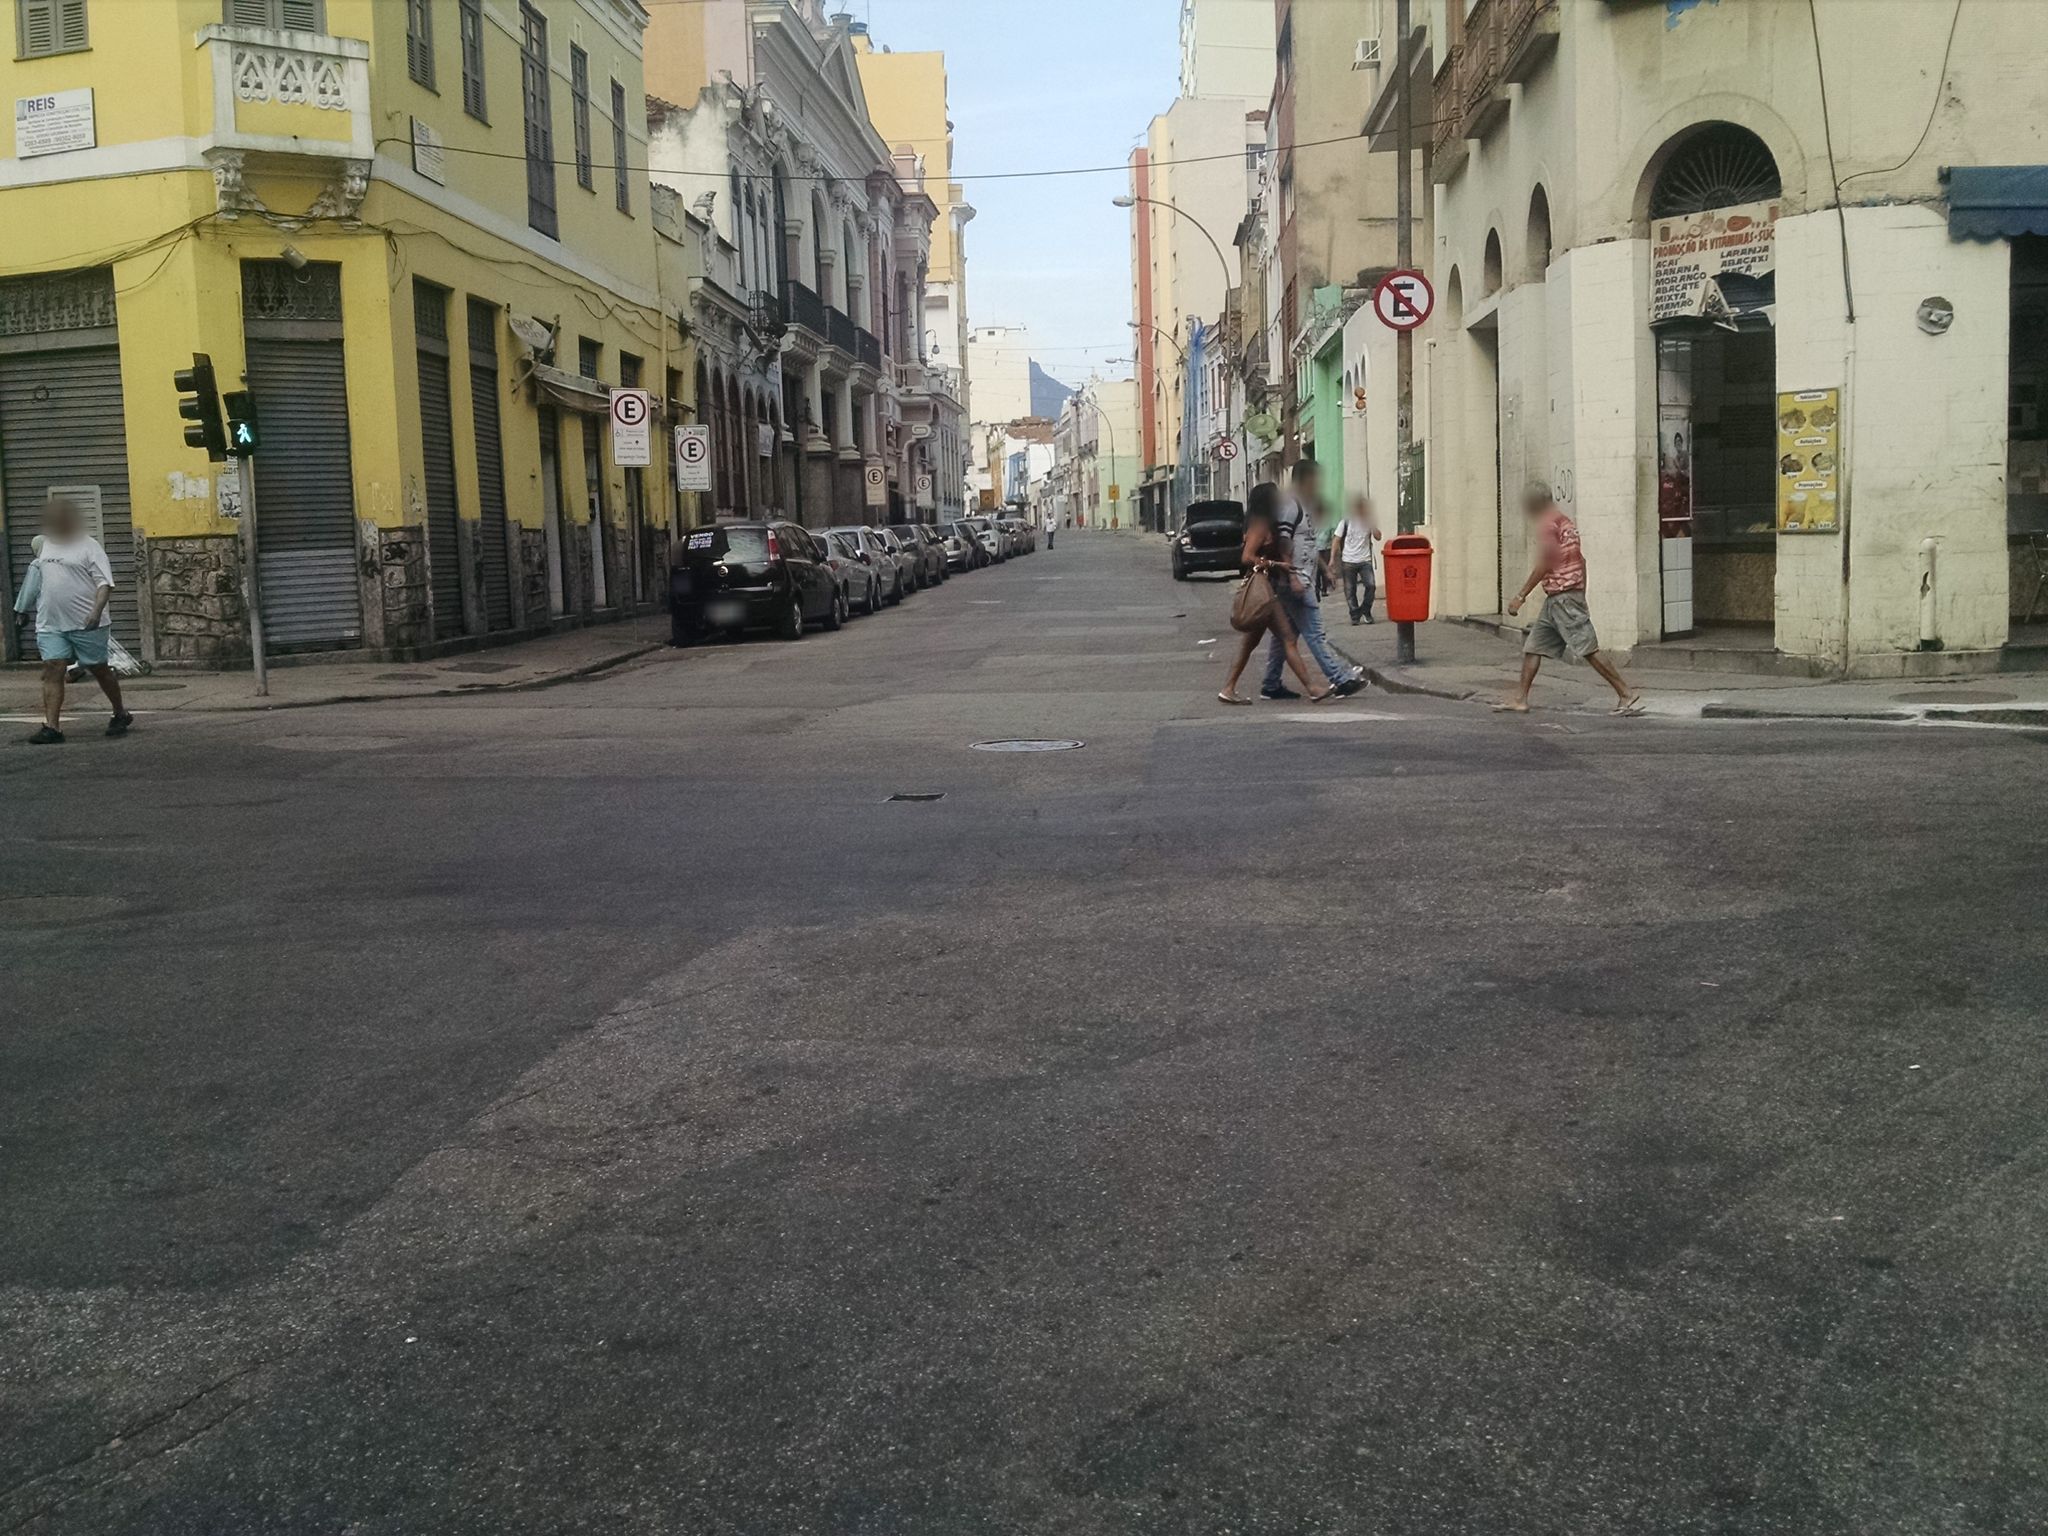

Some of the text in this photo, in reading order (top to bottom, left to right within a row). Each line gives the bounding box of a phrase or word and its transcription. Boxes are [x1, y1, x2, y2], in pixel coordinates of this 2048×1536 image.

[27, 97, 55, 112] REIS
[1699, 239, 1708, 251] DE
[1720, 245, 1769, 259] LARANJA
[1720, 254, 1768, 268] ABACAXI
[1655, 264, 1700, 278] BANANA
[1654, 271, 1707, 287] MORANGO
[1655, 280, 1700, 295] ABACATE
[1392, 283, 1415, 317] E
[1655, 292, 1687, 304] MIXTA
[624, 400, 636, 419] E
[687, 442, 698, 458] E
[872, 471, 879, 482] E
